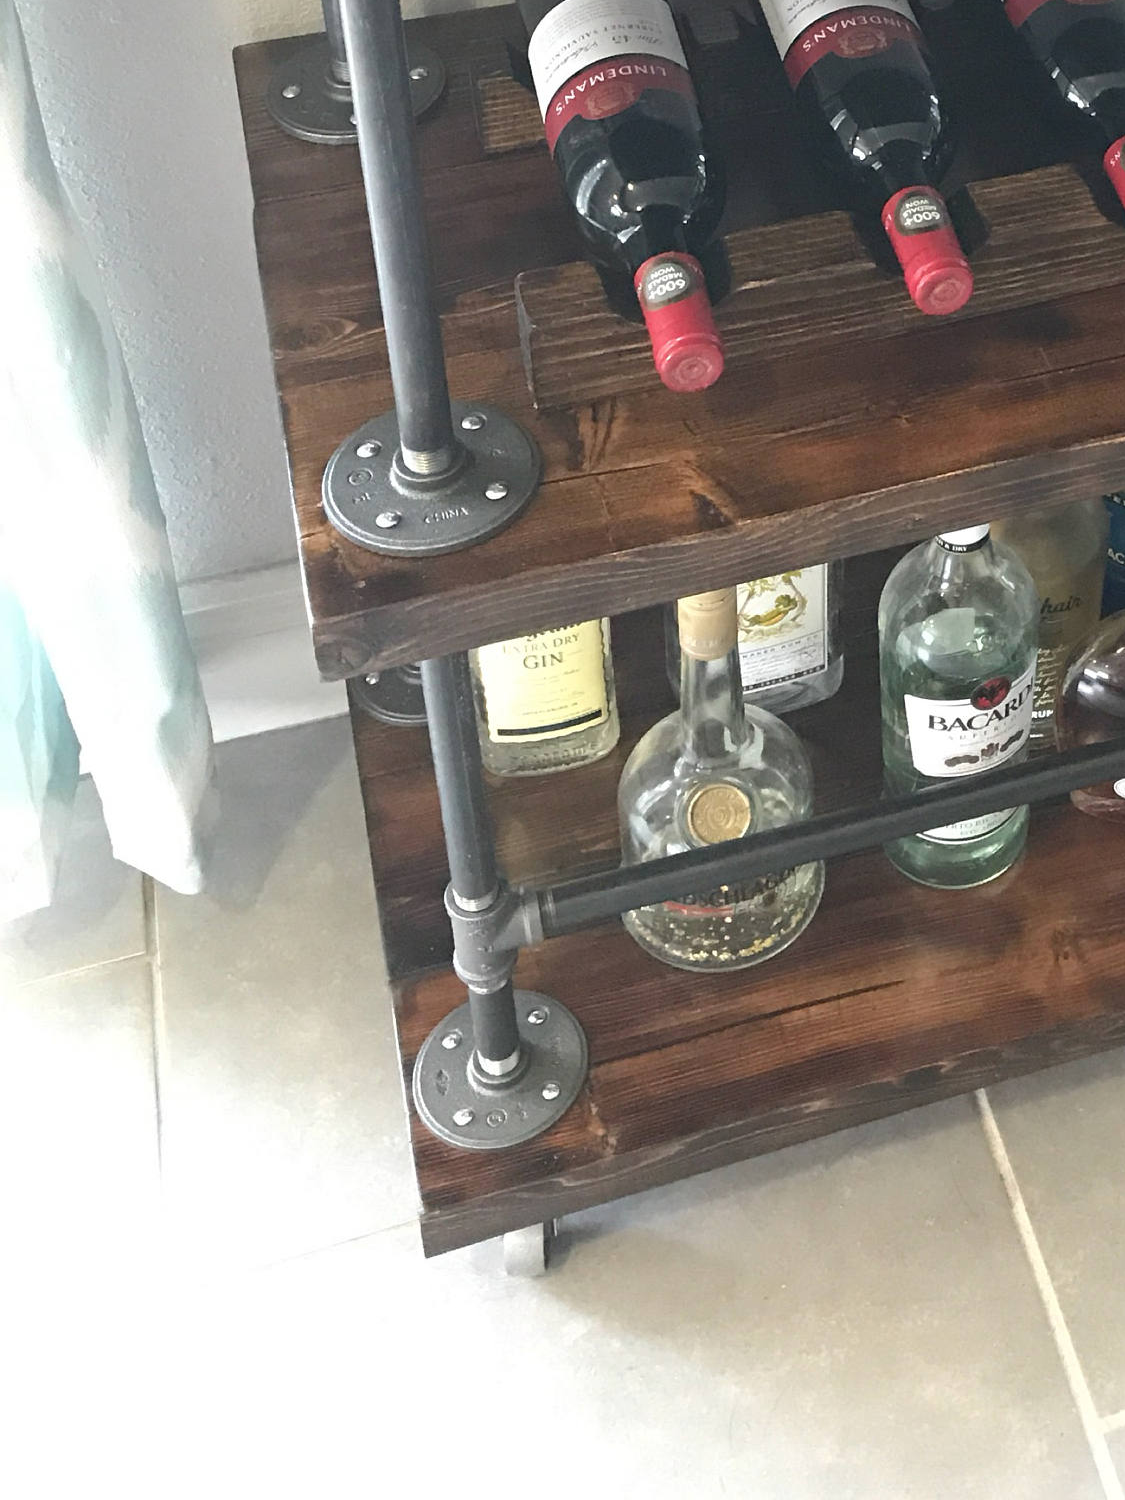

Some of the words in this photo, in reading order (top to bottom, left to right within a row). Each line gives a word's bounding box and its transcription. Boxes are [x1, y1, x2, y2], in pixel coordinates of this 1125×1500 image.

[801, 14, 912, 54] LINDEMAN'S
[554, 64, 667, 117] LINDEMAN'S
[902, 205, 937, 219] MEDALS
[905, 199, 929, 209] WON
[903, 211, 941, 226] 600+
[647, 272, 683, 291] MEDALS
[650, 266, 676, 280] WON
[648, 279, 686, 301] 600+
[1040, 595, 1082, 615] hair
[552, 632, 581, 648] DRY
[523, 651, 564, 670] GIN
[928, 675, 1035, 732] BACARDI
